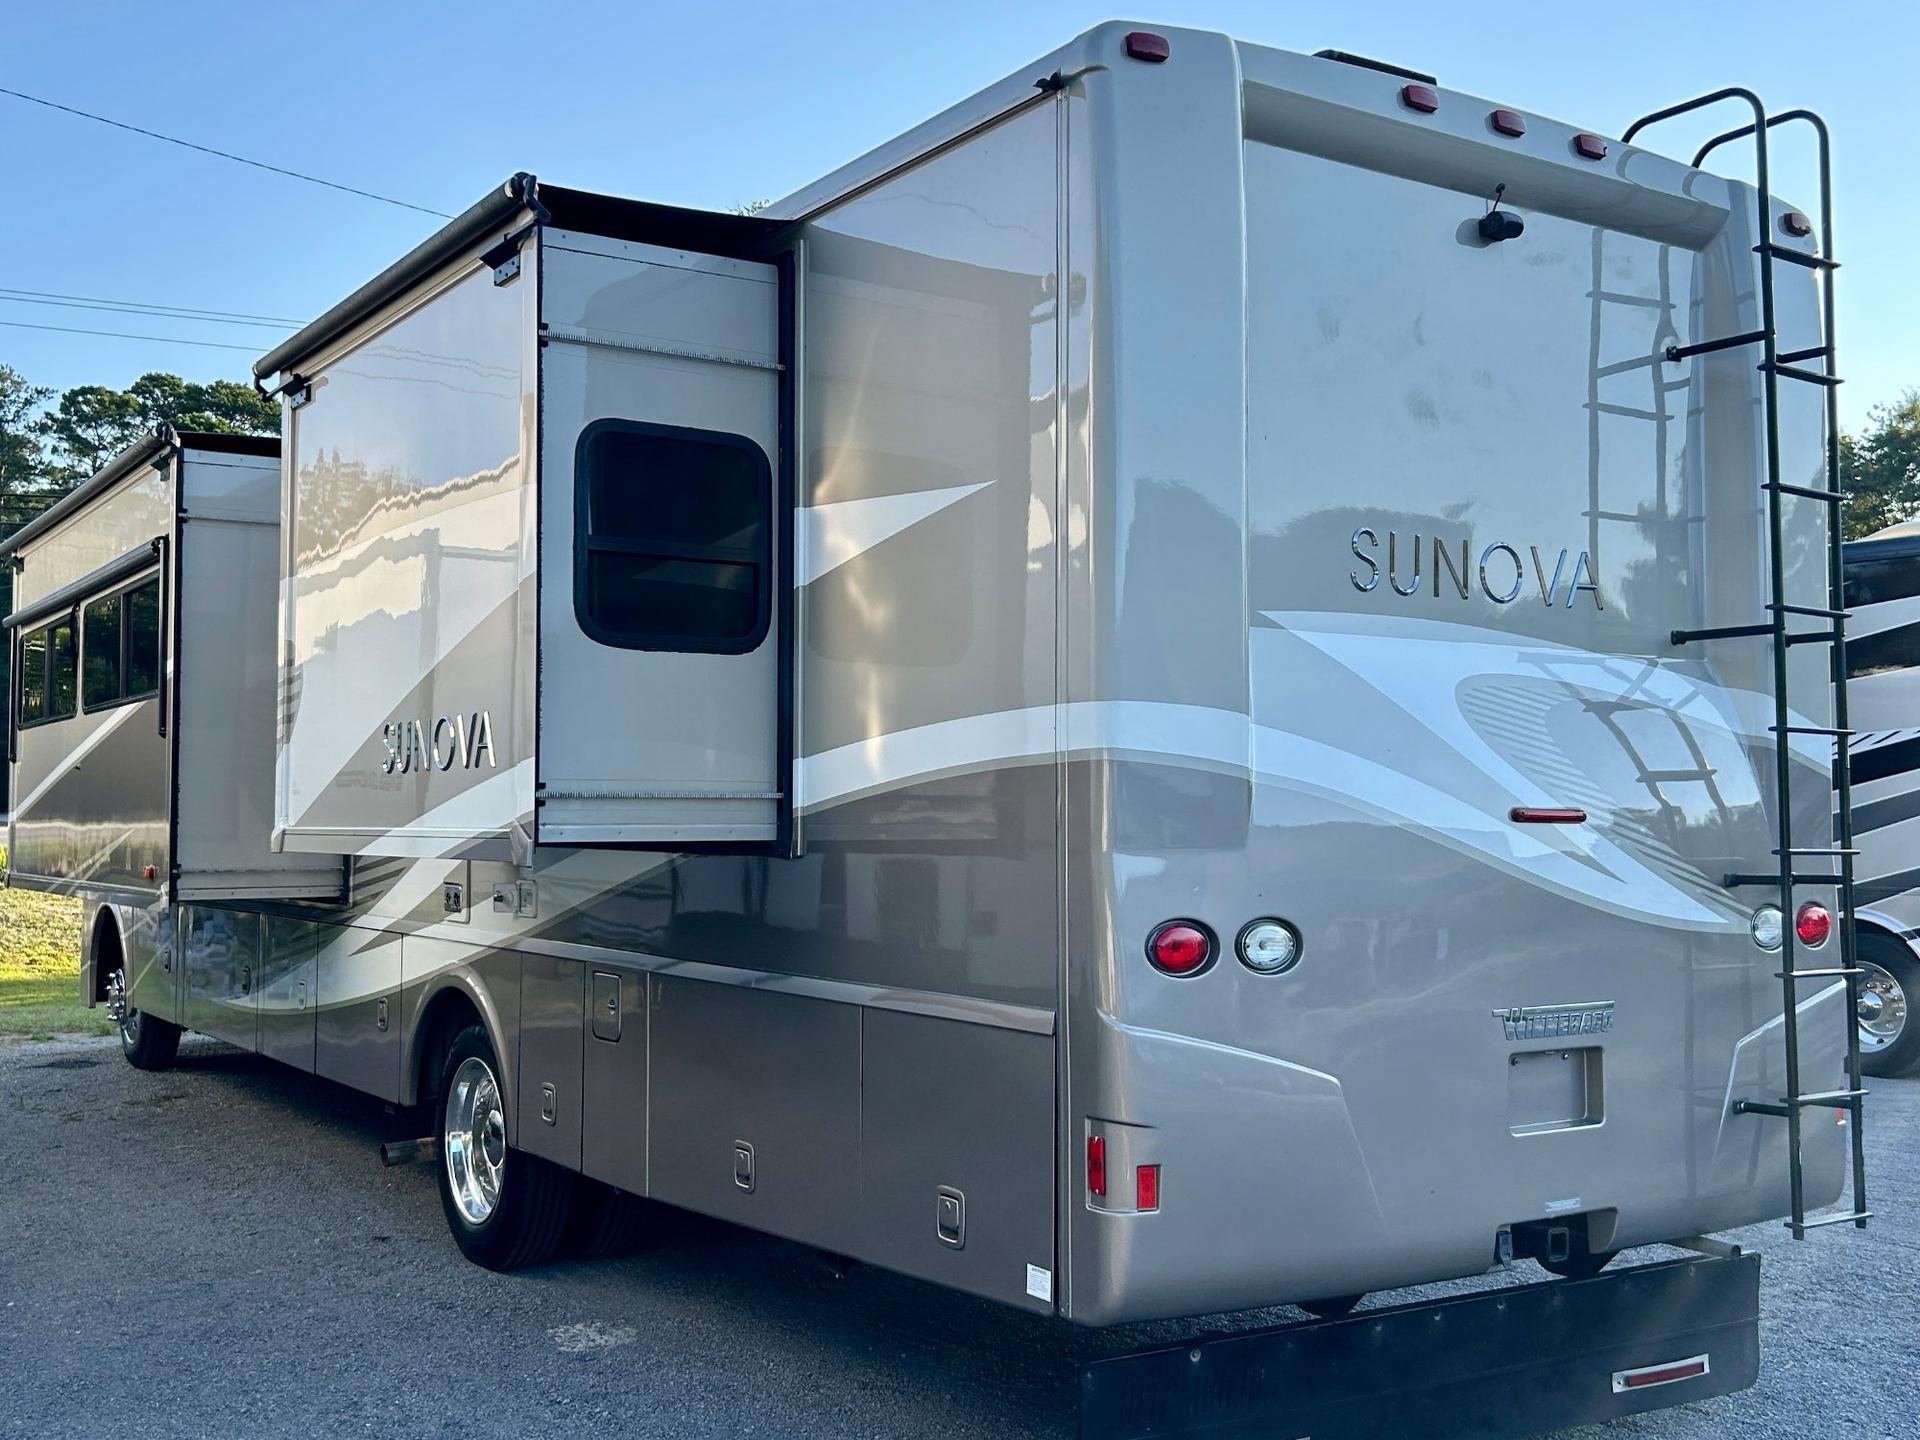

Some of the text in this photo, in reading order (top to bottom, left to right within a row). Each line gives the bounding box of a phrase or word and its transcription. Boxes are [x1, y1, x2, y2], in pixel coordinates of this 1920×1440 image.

[1350, 527, 1604, 610] SUNOVA
[382, 710, 496, 774] SUNOVA
[1492, 1001, 1615, 1041] WINNEBAGO
